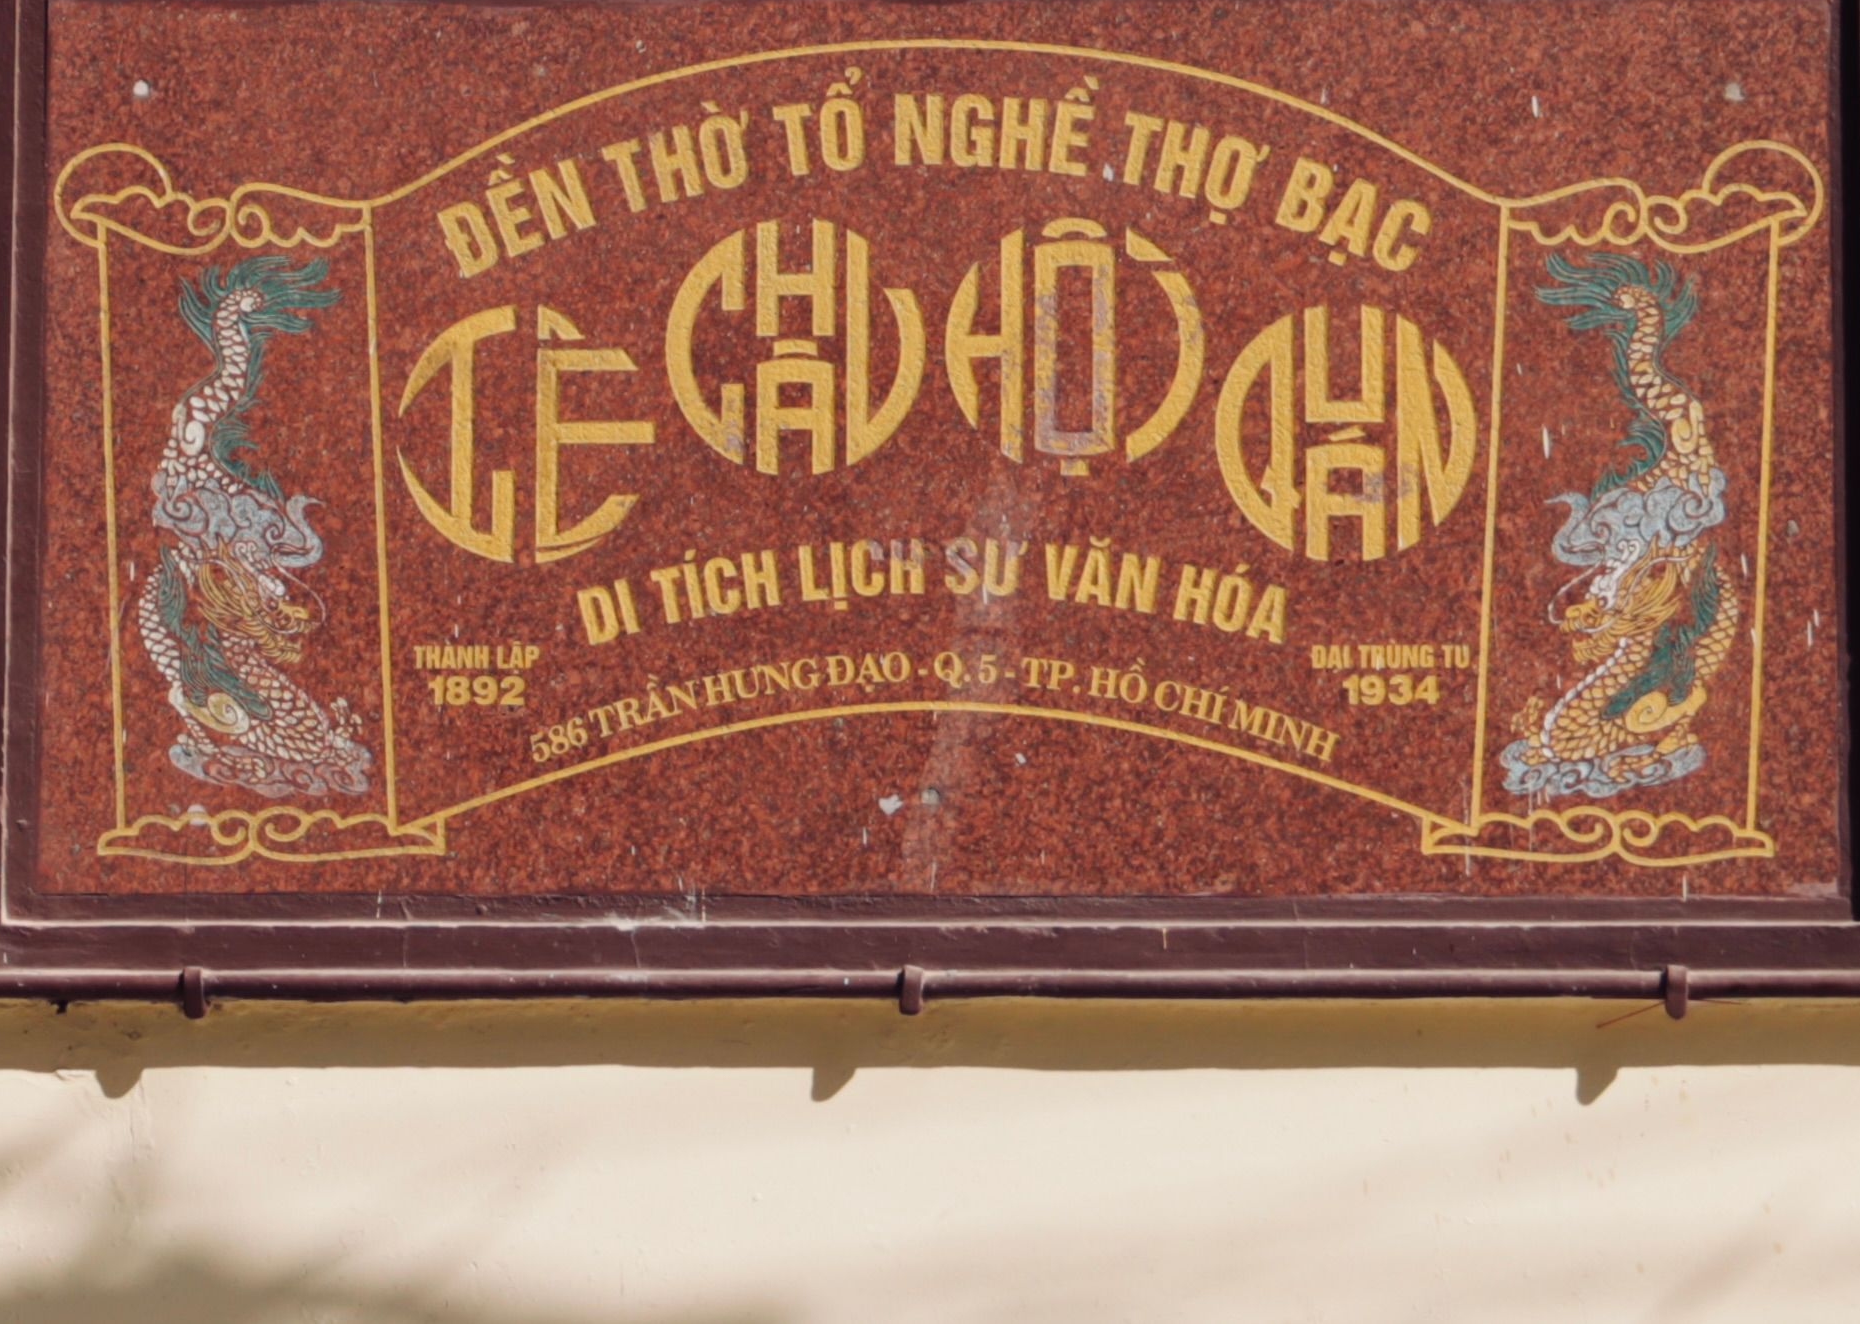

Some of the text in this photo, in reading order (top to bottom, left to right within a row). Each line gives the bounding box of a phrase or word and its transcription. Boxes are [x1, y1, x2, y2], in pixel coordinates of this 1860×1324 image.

[438, 66, 1432, 278] ĐỀN THỜ TỔ NGHỀ THỢ BẠC
[665, 217, 927, 476] CHÂU
[1214, 303, 1477, 562] QUÁN
[577, 577, 641, 646] DI
[650, 549, 782, 625] TÍCH
[798, 538, 926, 611] LỊCH
[1045, 535, 1161, 614] VĂN
[1173, 563, 1286, 644] HÓA
[413, 638, 489, 670] THÀNH
[428, 674, 525, 706] 1892
[529, 716, 589, 764] 586
[587, 673, 699, 739] TRẦN
[825, 651, 912, 693] ĐẠO
[1088, 656, 1149, 704] HỒ
[1153, 684, 1230, 725] CHÍ
[1227, 698, 1340, 762] MINH
[1342, 673, 1441, 706] 1934
